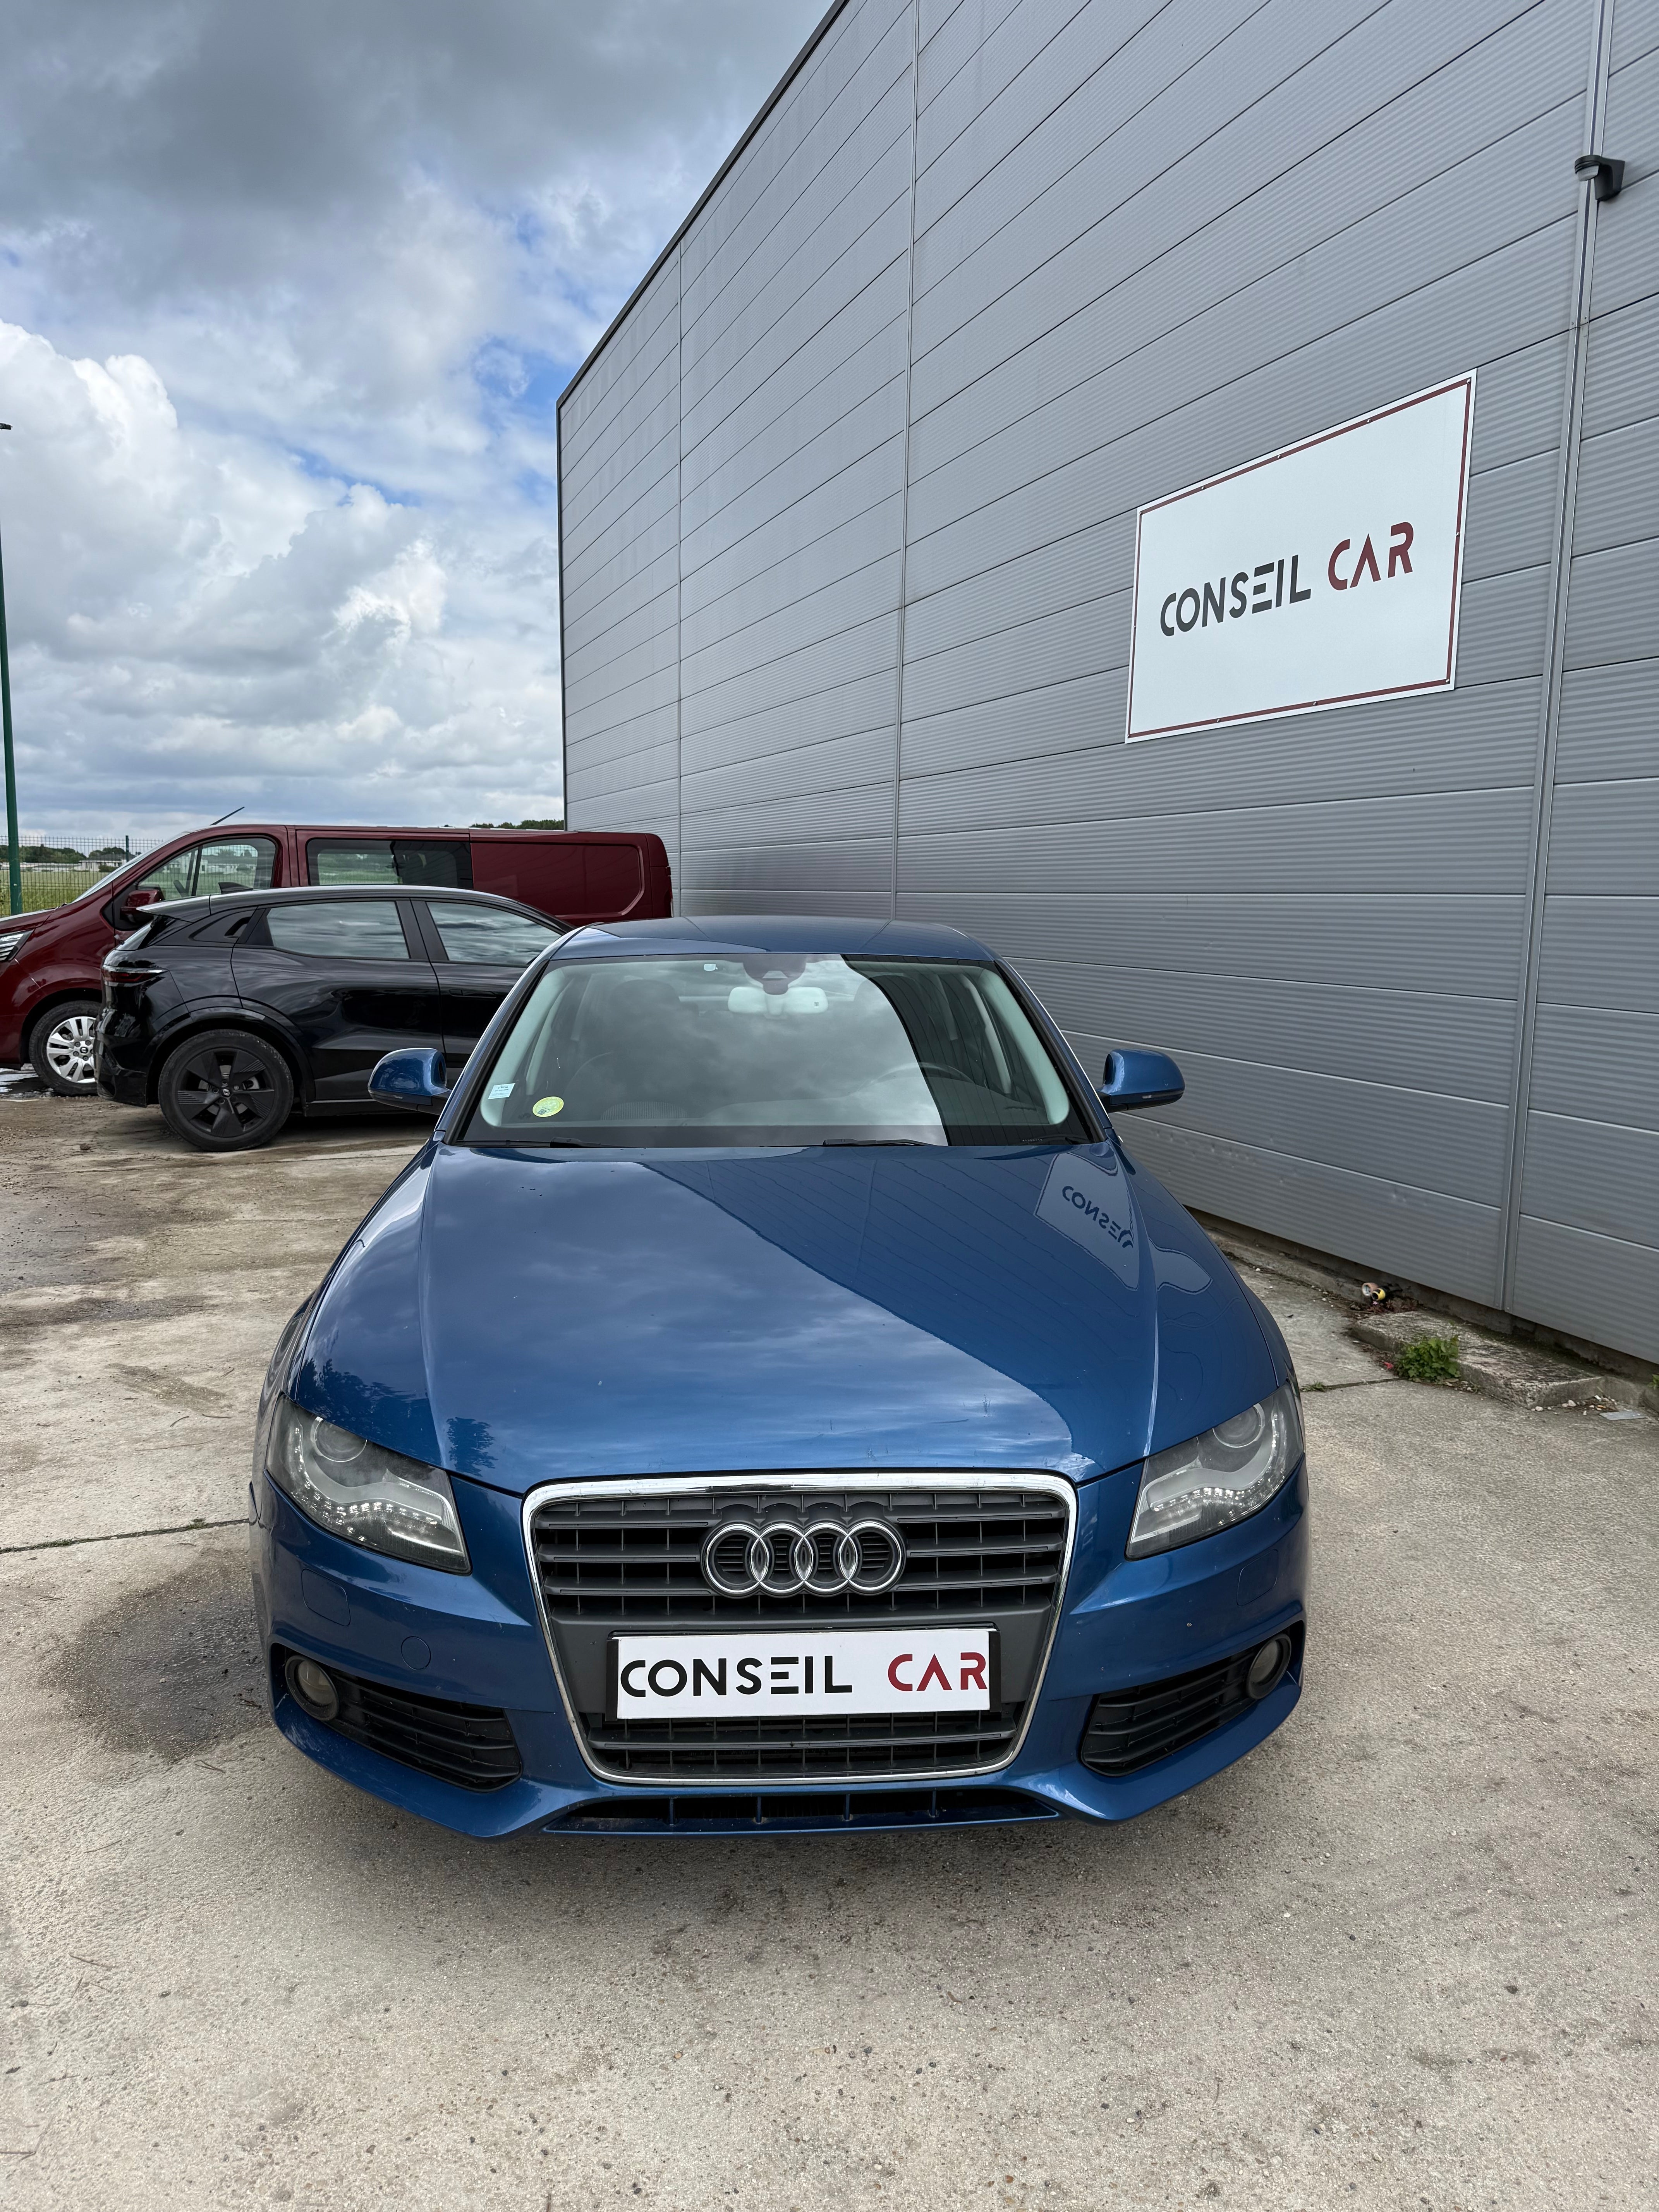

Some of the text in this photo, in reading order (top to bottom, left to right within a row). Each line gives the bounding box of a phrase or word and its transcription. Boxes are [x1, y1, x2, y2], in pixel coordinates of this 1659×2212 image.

[1160, 522, 1414, 637] CONSEIL CAR
[620, 1652, 988, 1697] CONSEIL CAR
